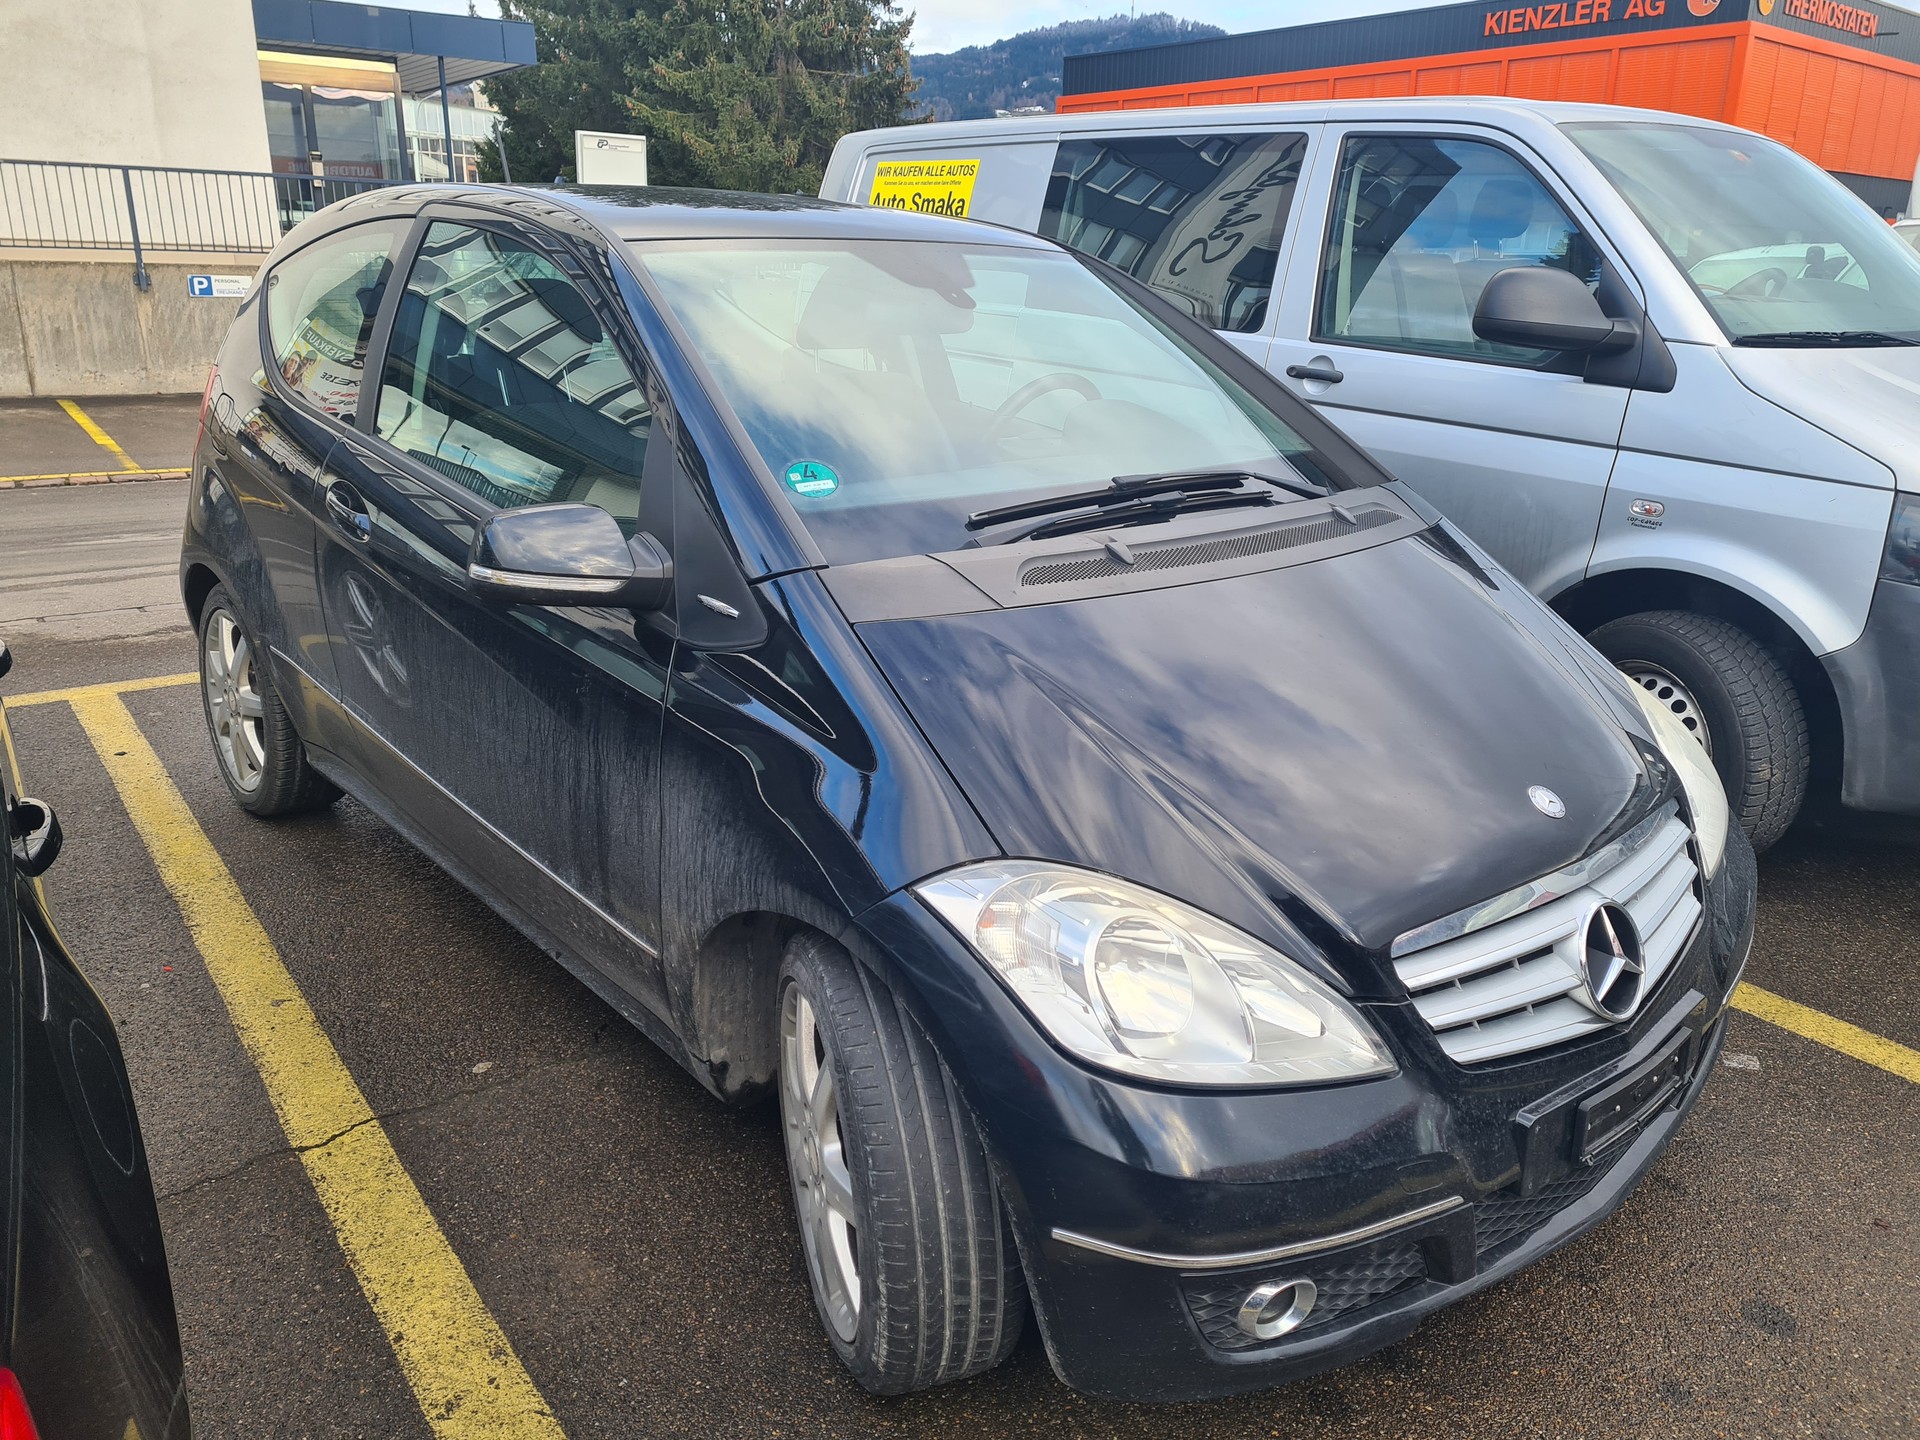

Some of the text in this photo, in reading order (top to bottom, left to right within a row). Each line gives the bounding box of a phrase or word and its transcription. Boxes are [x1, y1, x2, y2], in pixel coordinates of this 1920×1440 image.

[1483, 0, 1665, 36] KIENZLER AG
[877, 164, 976, 177] WIR KAUFEN ALLE AUTOS
[909, 191, 966, 216] Smaka
[193, 277, 208, 295] P
[803, 464, 817, 479] 4
